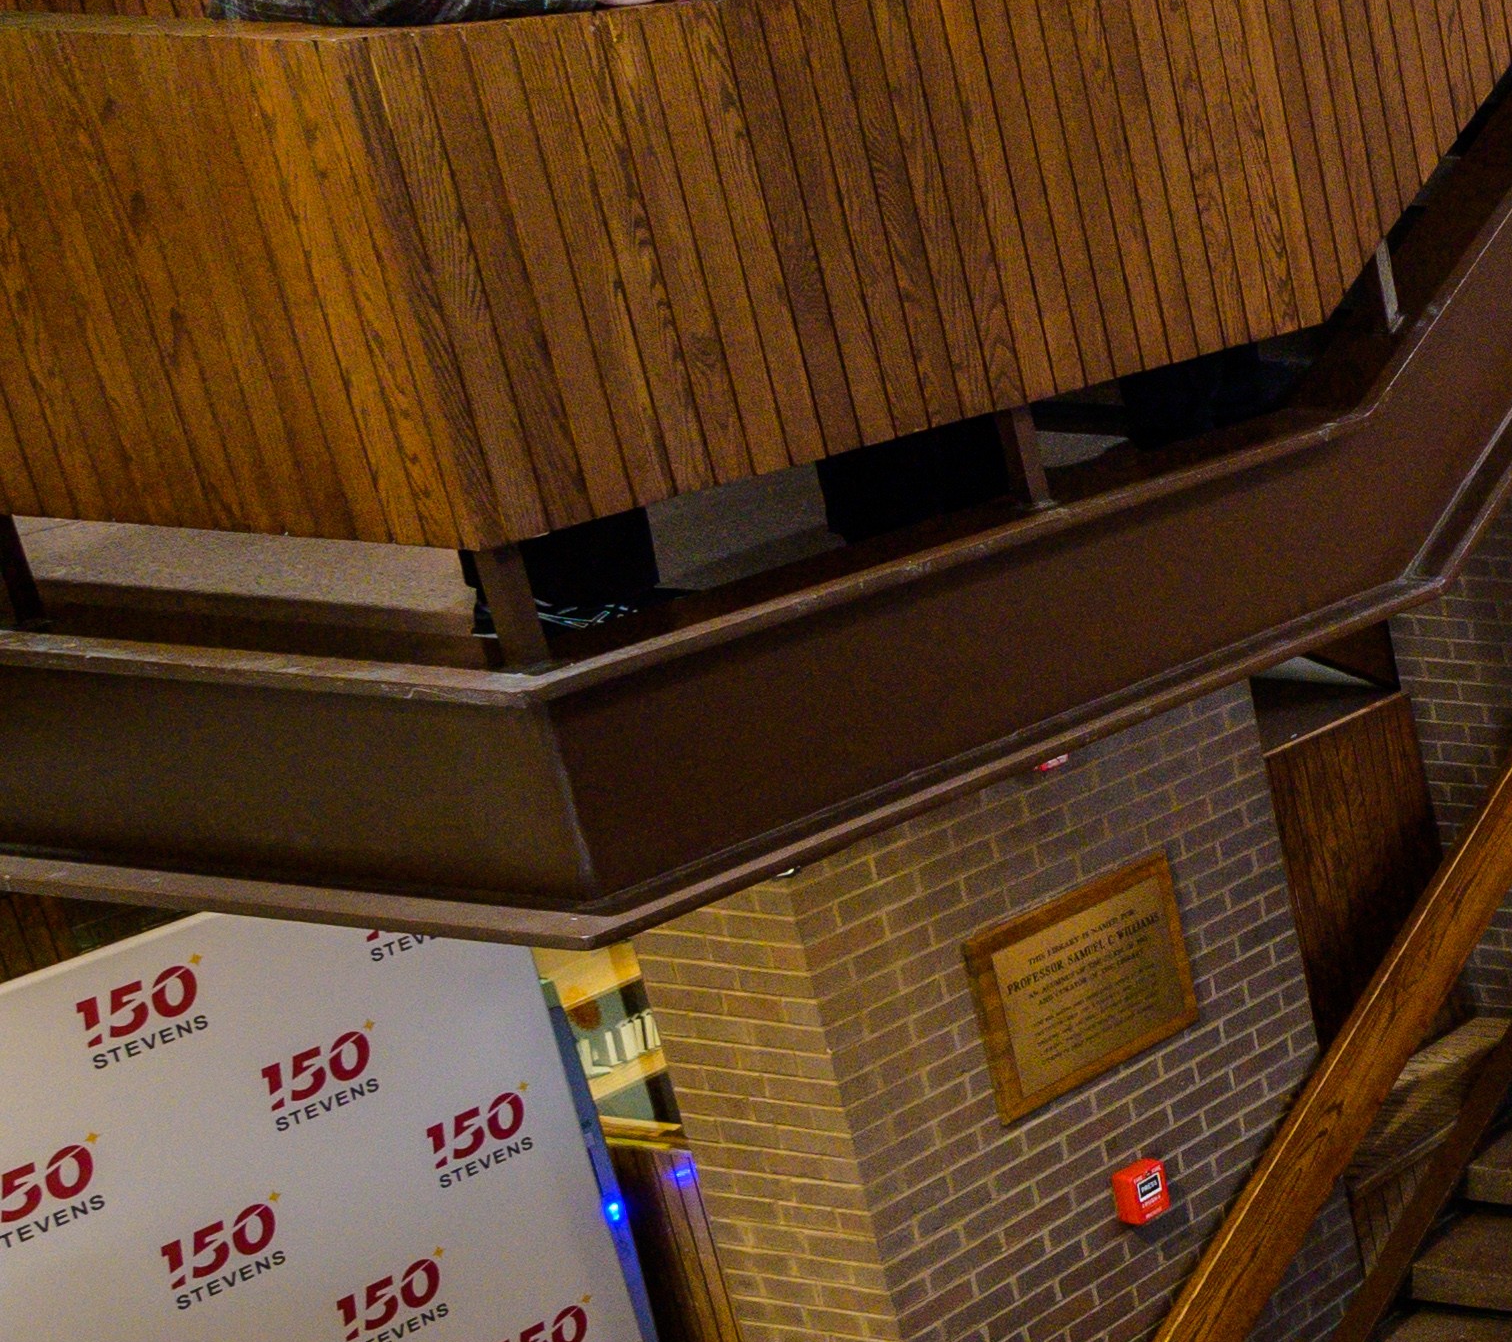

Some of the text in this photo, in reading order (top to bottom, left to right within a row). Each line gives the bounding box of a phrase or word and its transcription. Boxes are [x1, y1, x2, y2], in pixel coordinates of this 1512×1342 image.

[1007, 960, 1065, 996] PROFESSOR
[1067, 938, 1105, 966] SAMUEL
[1116, 911, 1161, 940] WILLIAMS
[77, 966, 196, 1047] 150
[93, 1015, 208, 1069] STEVENS
[262, 1032, 369, 1110] 150
[276, 1079, 379, 1131] STEVENS
[427, 1093, 523, 1168] 150
[440, 1137, 532, 1188] STEVENS
[0, 1195, 104, 1247] TEVENS
[162, 1204, 275, 1288] 150
[177, 1251, 285, 1309] STEVENS
[337, 1259, 439, 1340] 150
